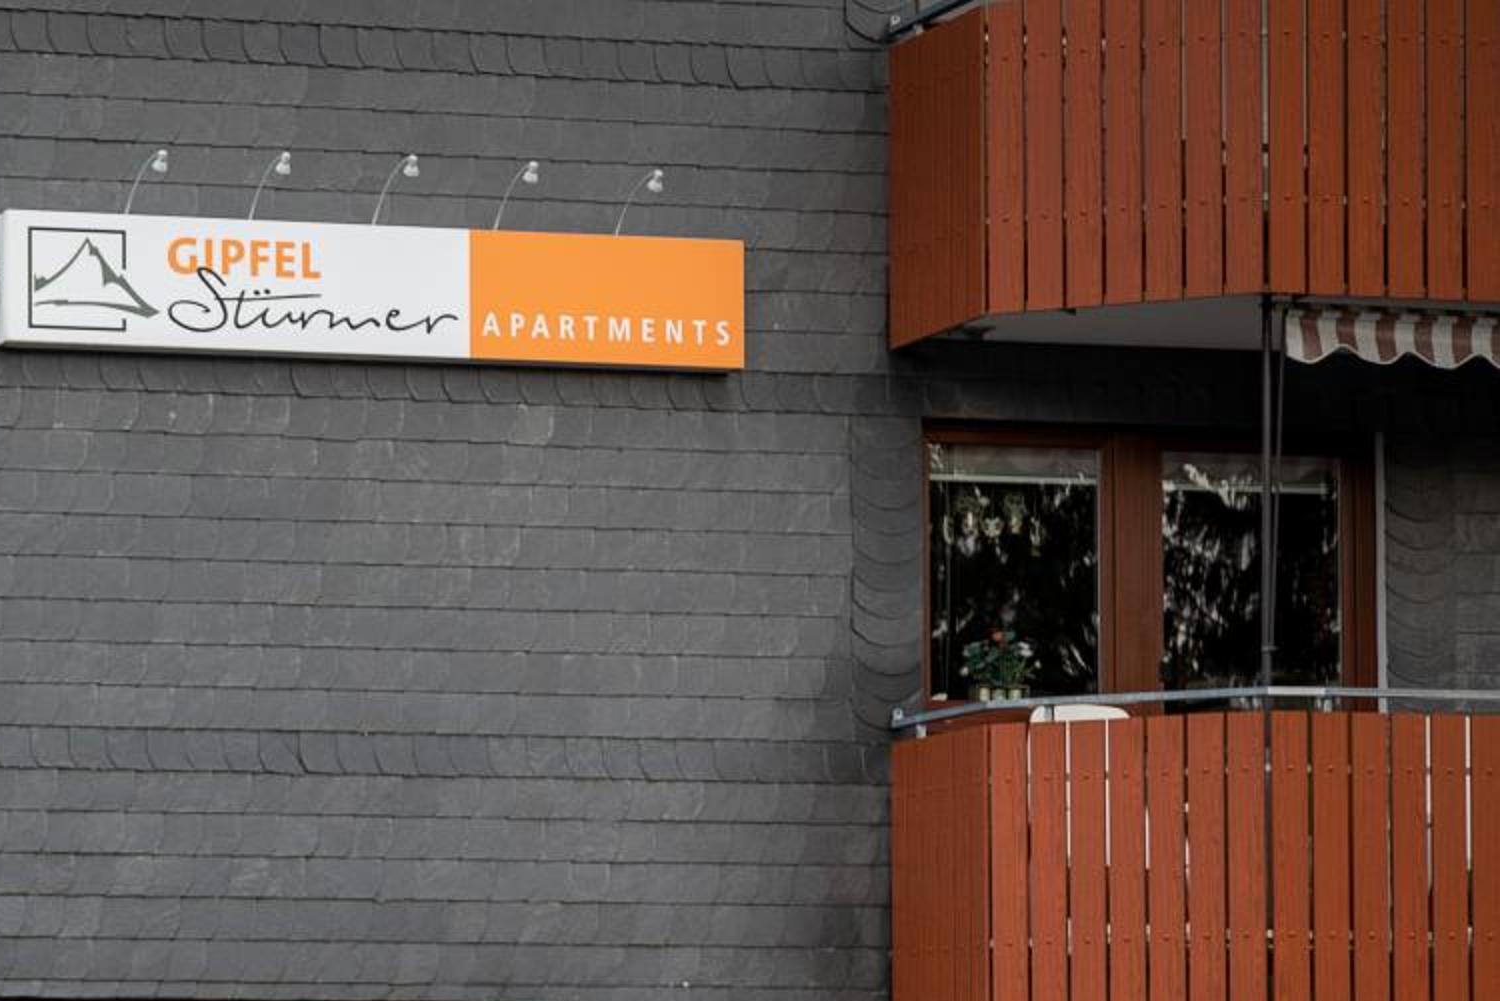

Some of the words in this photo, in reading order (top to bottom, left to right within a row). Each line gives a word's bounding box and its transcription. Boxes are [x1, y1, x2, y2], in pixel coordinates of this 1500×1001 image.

[166, 236, 322, 280] GIPFEL
[167, 267, 459, 334] Stürmer
[482, 312, 732, 347] APARTMENTS
